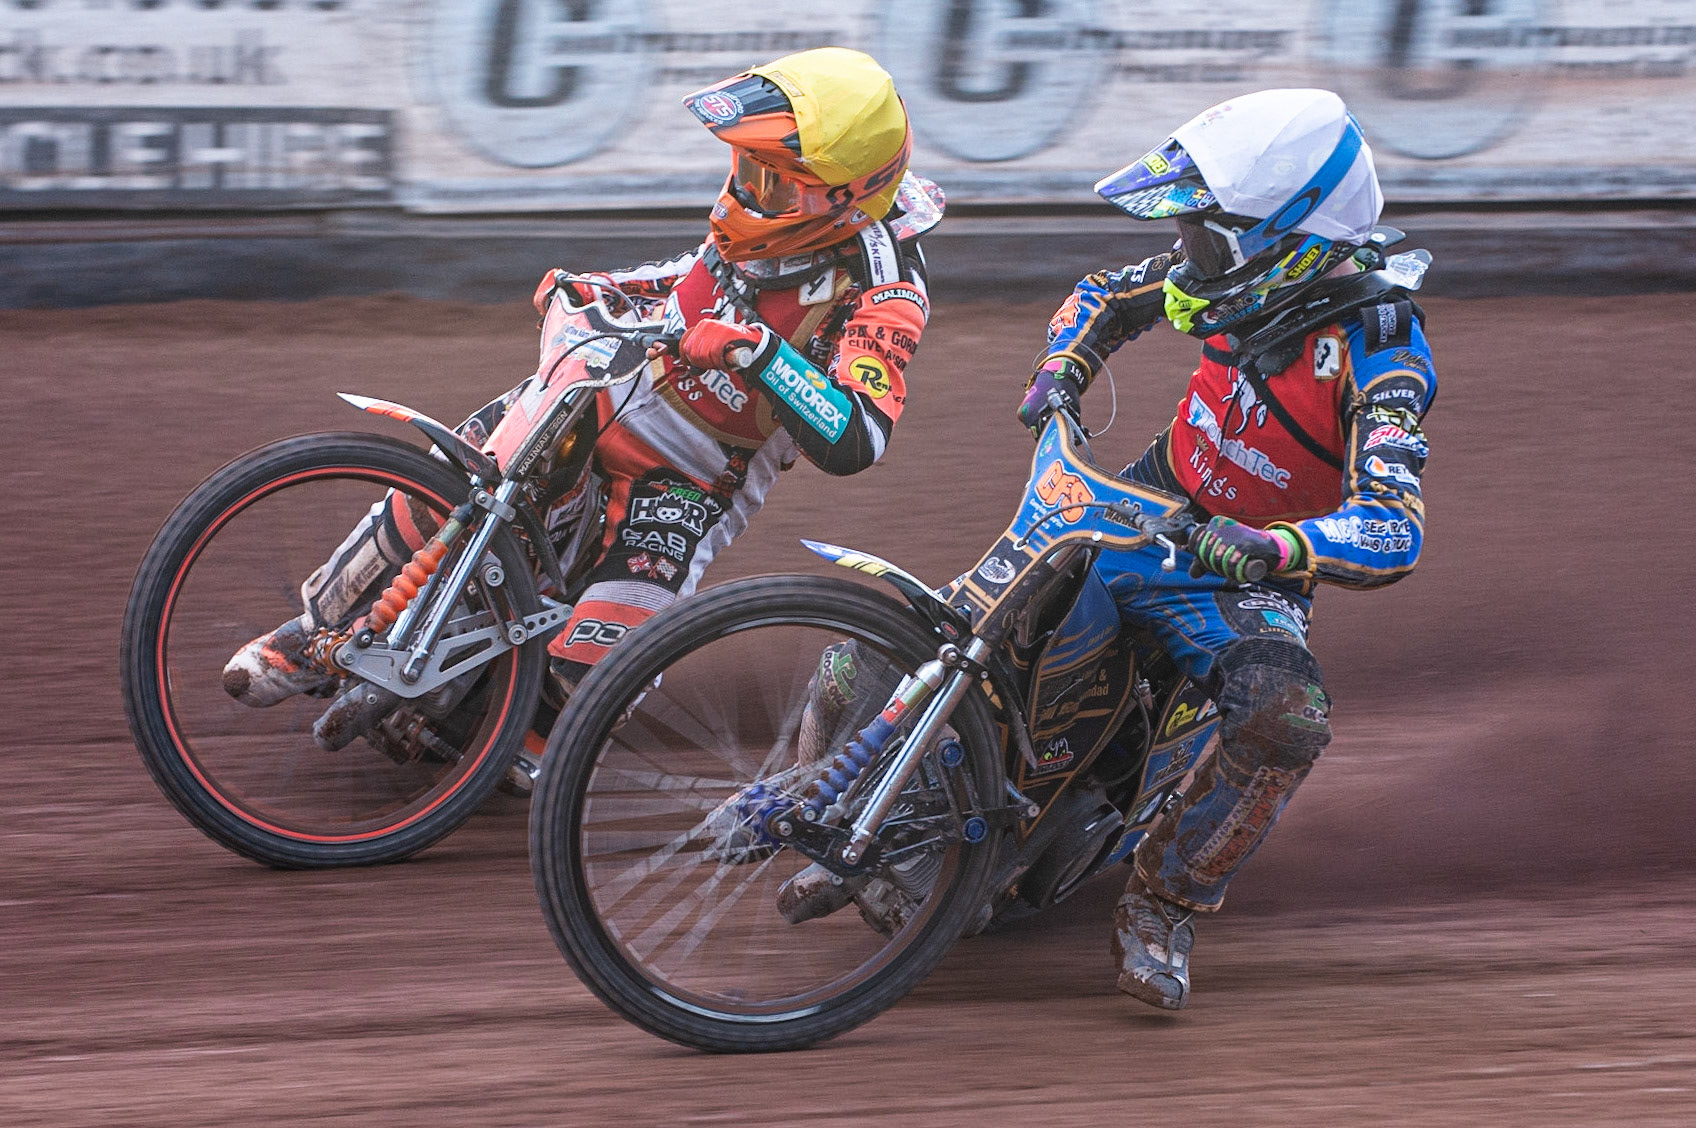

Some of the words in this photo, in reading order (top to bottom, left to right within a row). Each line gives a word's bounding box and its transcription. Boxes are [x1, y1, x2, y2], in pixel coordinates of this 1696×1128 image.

[1286, 246, 1322, 280] SHOEI
[765, 370, 778, 385] Oil
[778, 382, 789, 395] of
[788, 392, 838, 439] Switzerland
[771, 355, 843, 429] MOTOREX
[1372, 389, 1416, 404] SILVER
[625, 539, 684, 562] RACING
